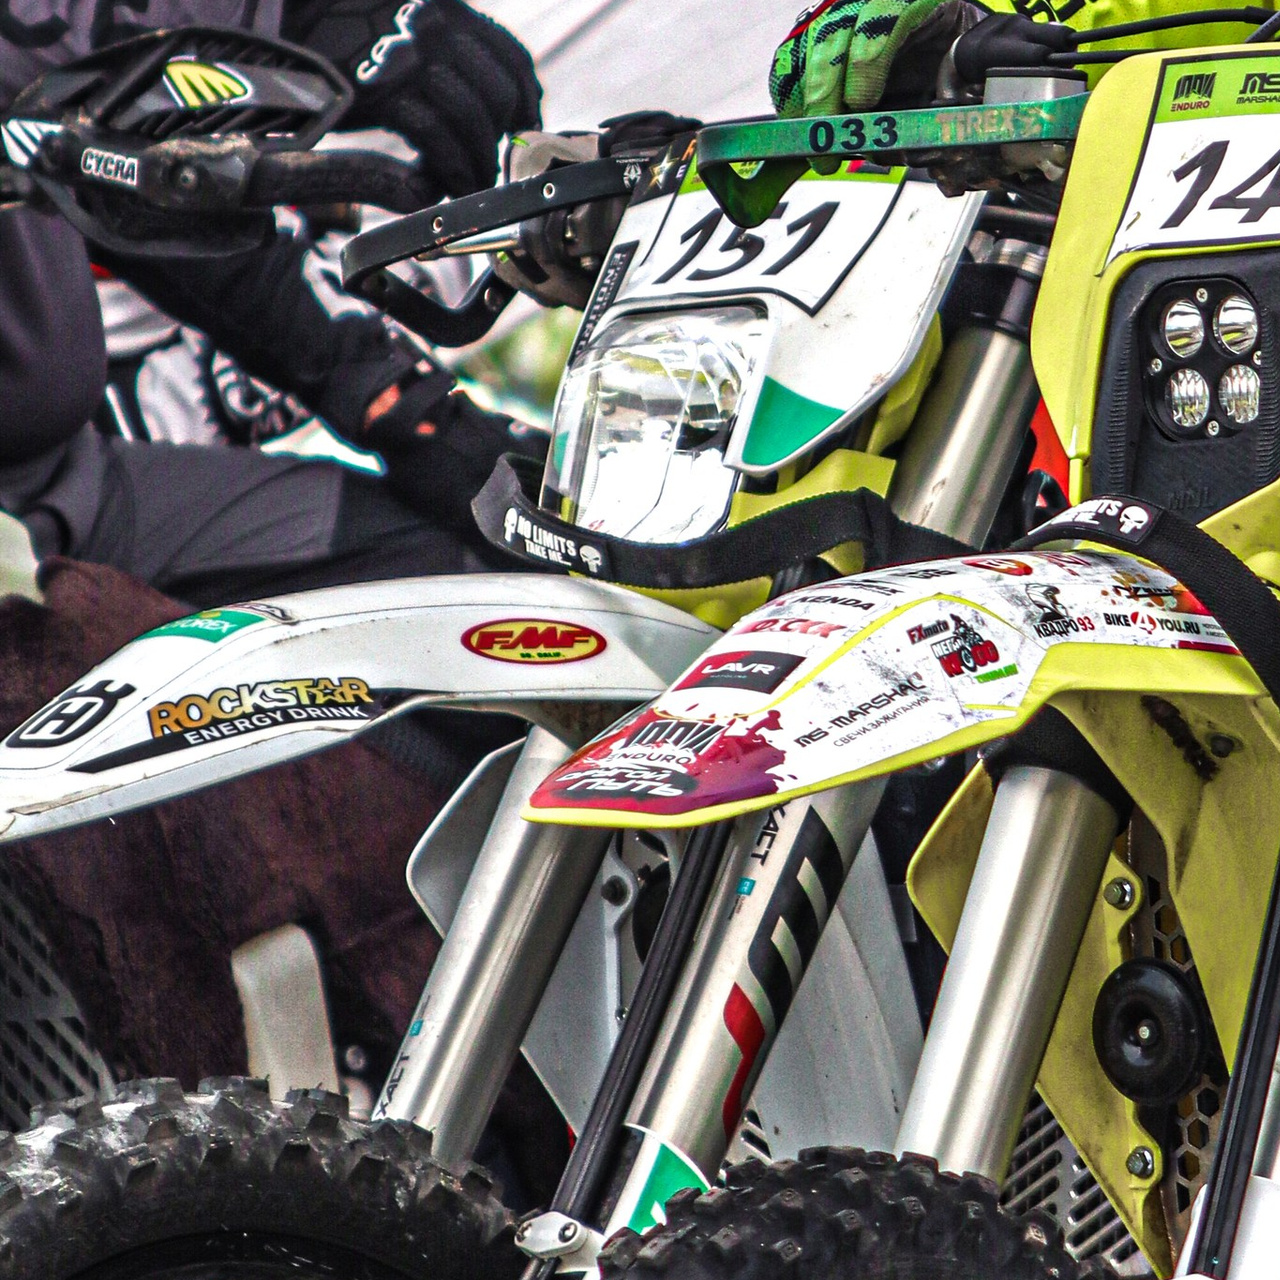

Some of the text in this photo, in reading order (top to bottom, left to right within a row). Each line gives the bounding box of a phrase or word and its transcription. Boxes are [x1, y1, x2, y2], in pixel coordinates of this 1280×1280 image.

[1170, 100, 1211, 112] ENDURO
[808, 115, 900, 154] 033
[81, 147, 139, 186] CYCRA
[651, 201, 841, 285] 151
[517, 515, 577, 557] NO LIMITS
[793, 595, 876, 611] KENDA
[474, 626, 592, 650] FMF
[701, 662, 776, 675] LAVR
[147, 677, 374, 739] ROCKSTAR
[183, 704, 369, 746] ENERGY DRINK
[607, 752, 692, 766] ENDURO
[566, 778, 685, 798] ПУТЬ
